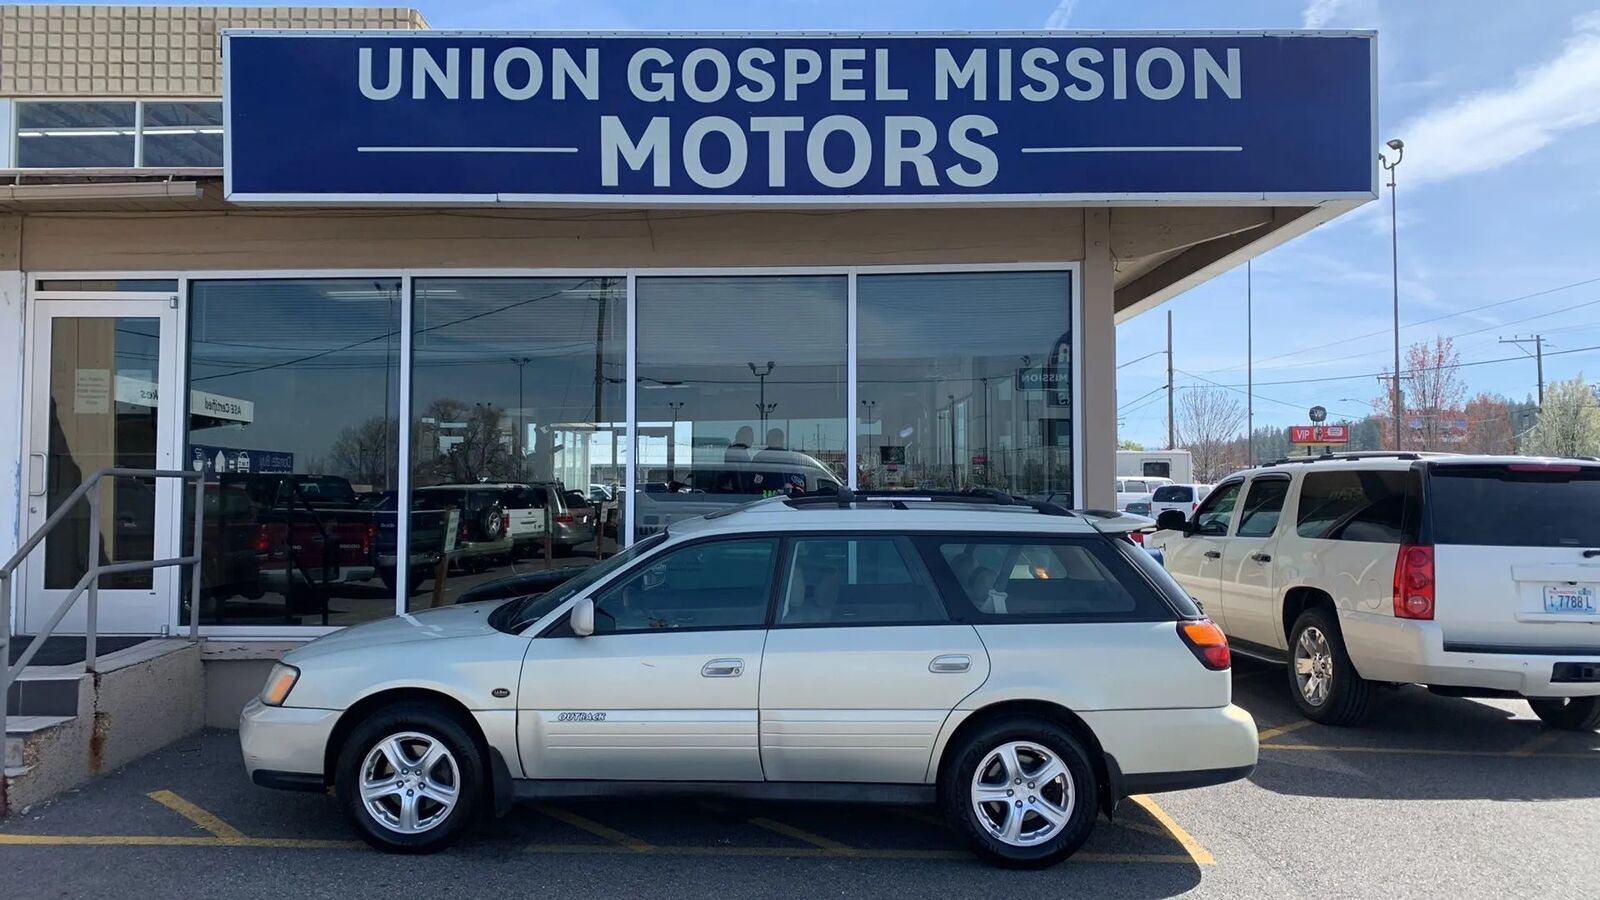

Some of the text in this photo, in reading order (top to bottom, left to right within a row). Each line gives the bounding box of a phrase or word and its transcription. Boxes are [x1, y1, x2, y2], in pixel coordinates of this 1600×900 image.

[358, 47, 1242, 103] UNION GOSPEL MISSION
[600, 114, 1000, 189] MOTORS
[1296, 429, 1310, 440] VIP
[558, 712, 607, 722] OUTBACK
